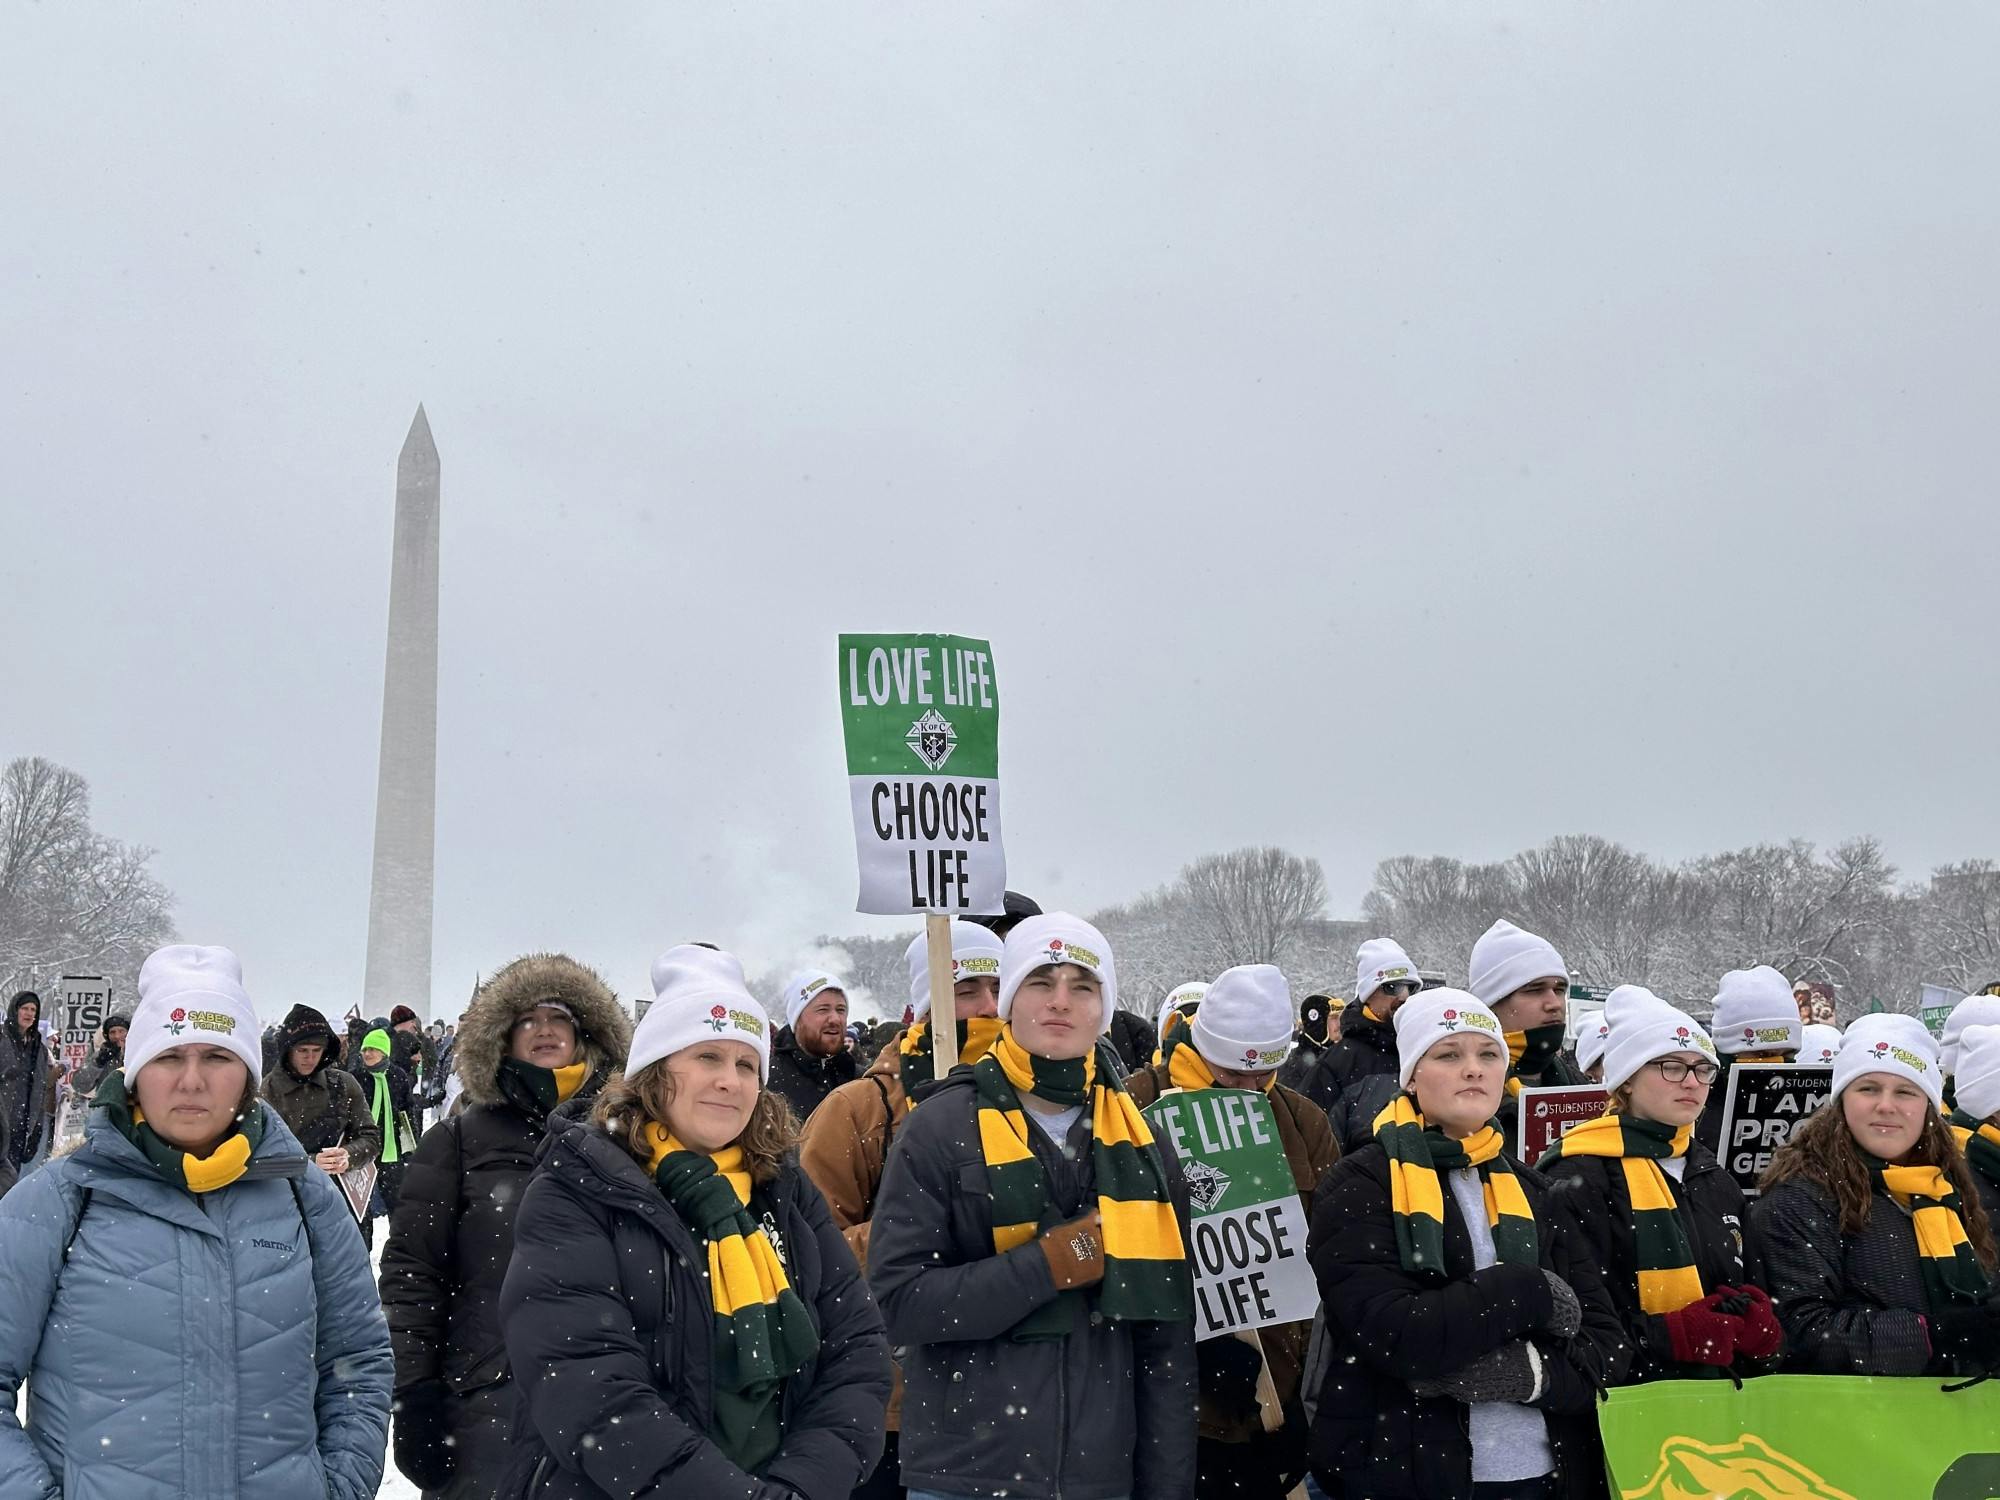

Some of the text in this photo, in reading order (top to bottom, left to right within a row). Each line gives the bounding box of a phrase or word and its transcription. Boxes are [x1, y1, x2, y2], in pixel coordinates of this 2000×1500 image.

[850, 647, 993, 708] LOVE LIFE
[921, 722, 928, 731] K
[939, 722, 946, 732] C
[871, 782, 989, 842] CHOOSE
[909, 850, 970, 908] LIFE
[66, 1006, 102, 1030] IS
[67, 992, 103, 1005] LIFE
[188, 1010, 236, 1029] SABERS
[1747, 1093, 1758, 1113] I
[1192, 1095, 1271, 1154] LIFE
[1196, 1272, 1276, 1332] LIFE
